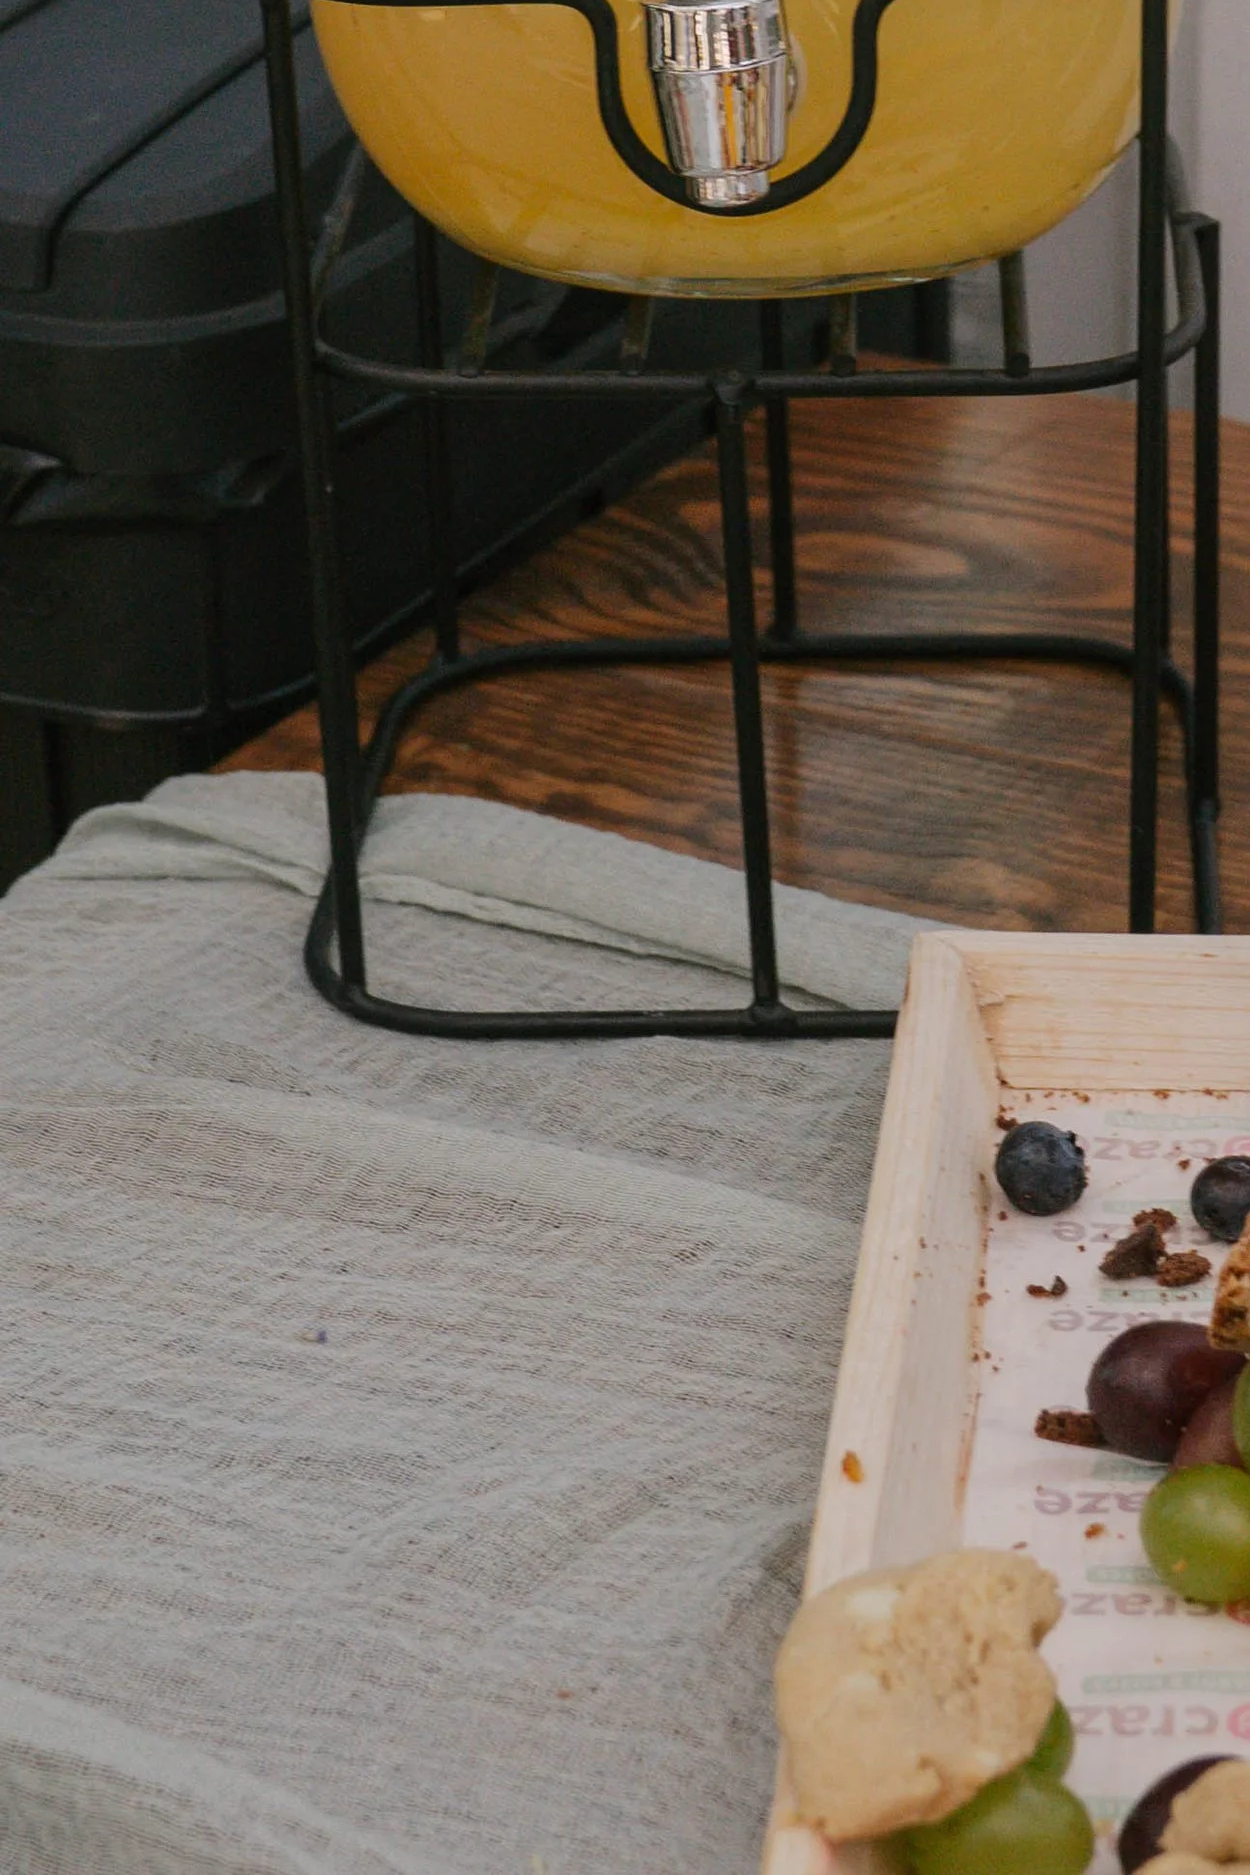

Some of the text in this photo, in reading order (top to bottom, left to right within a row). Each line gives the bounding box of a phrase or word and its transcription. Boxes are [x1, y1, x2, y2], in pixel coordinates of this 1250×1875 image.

[1076, 1136, 1219, 1162] craz
[1061, 1593, 1220, 1617] craz
[1069, 1704, 1219, 1739] craz
